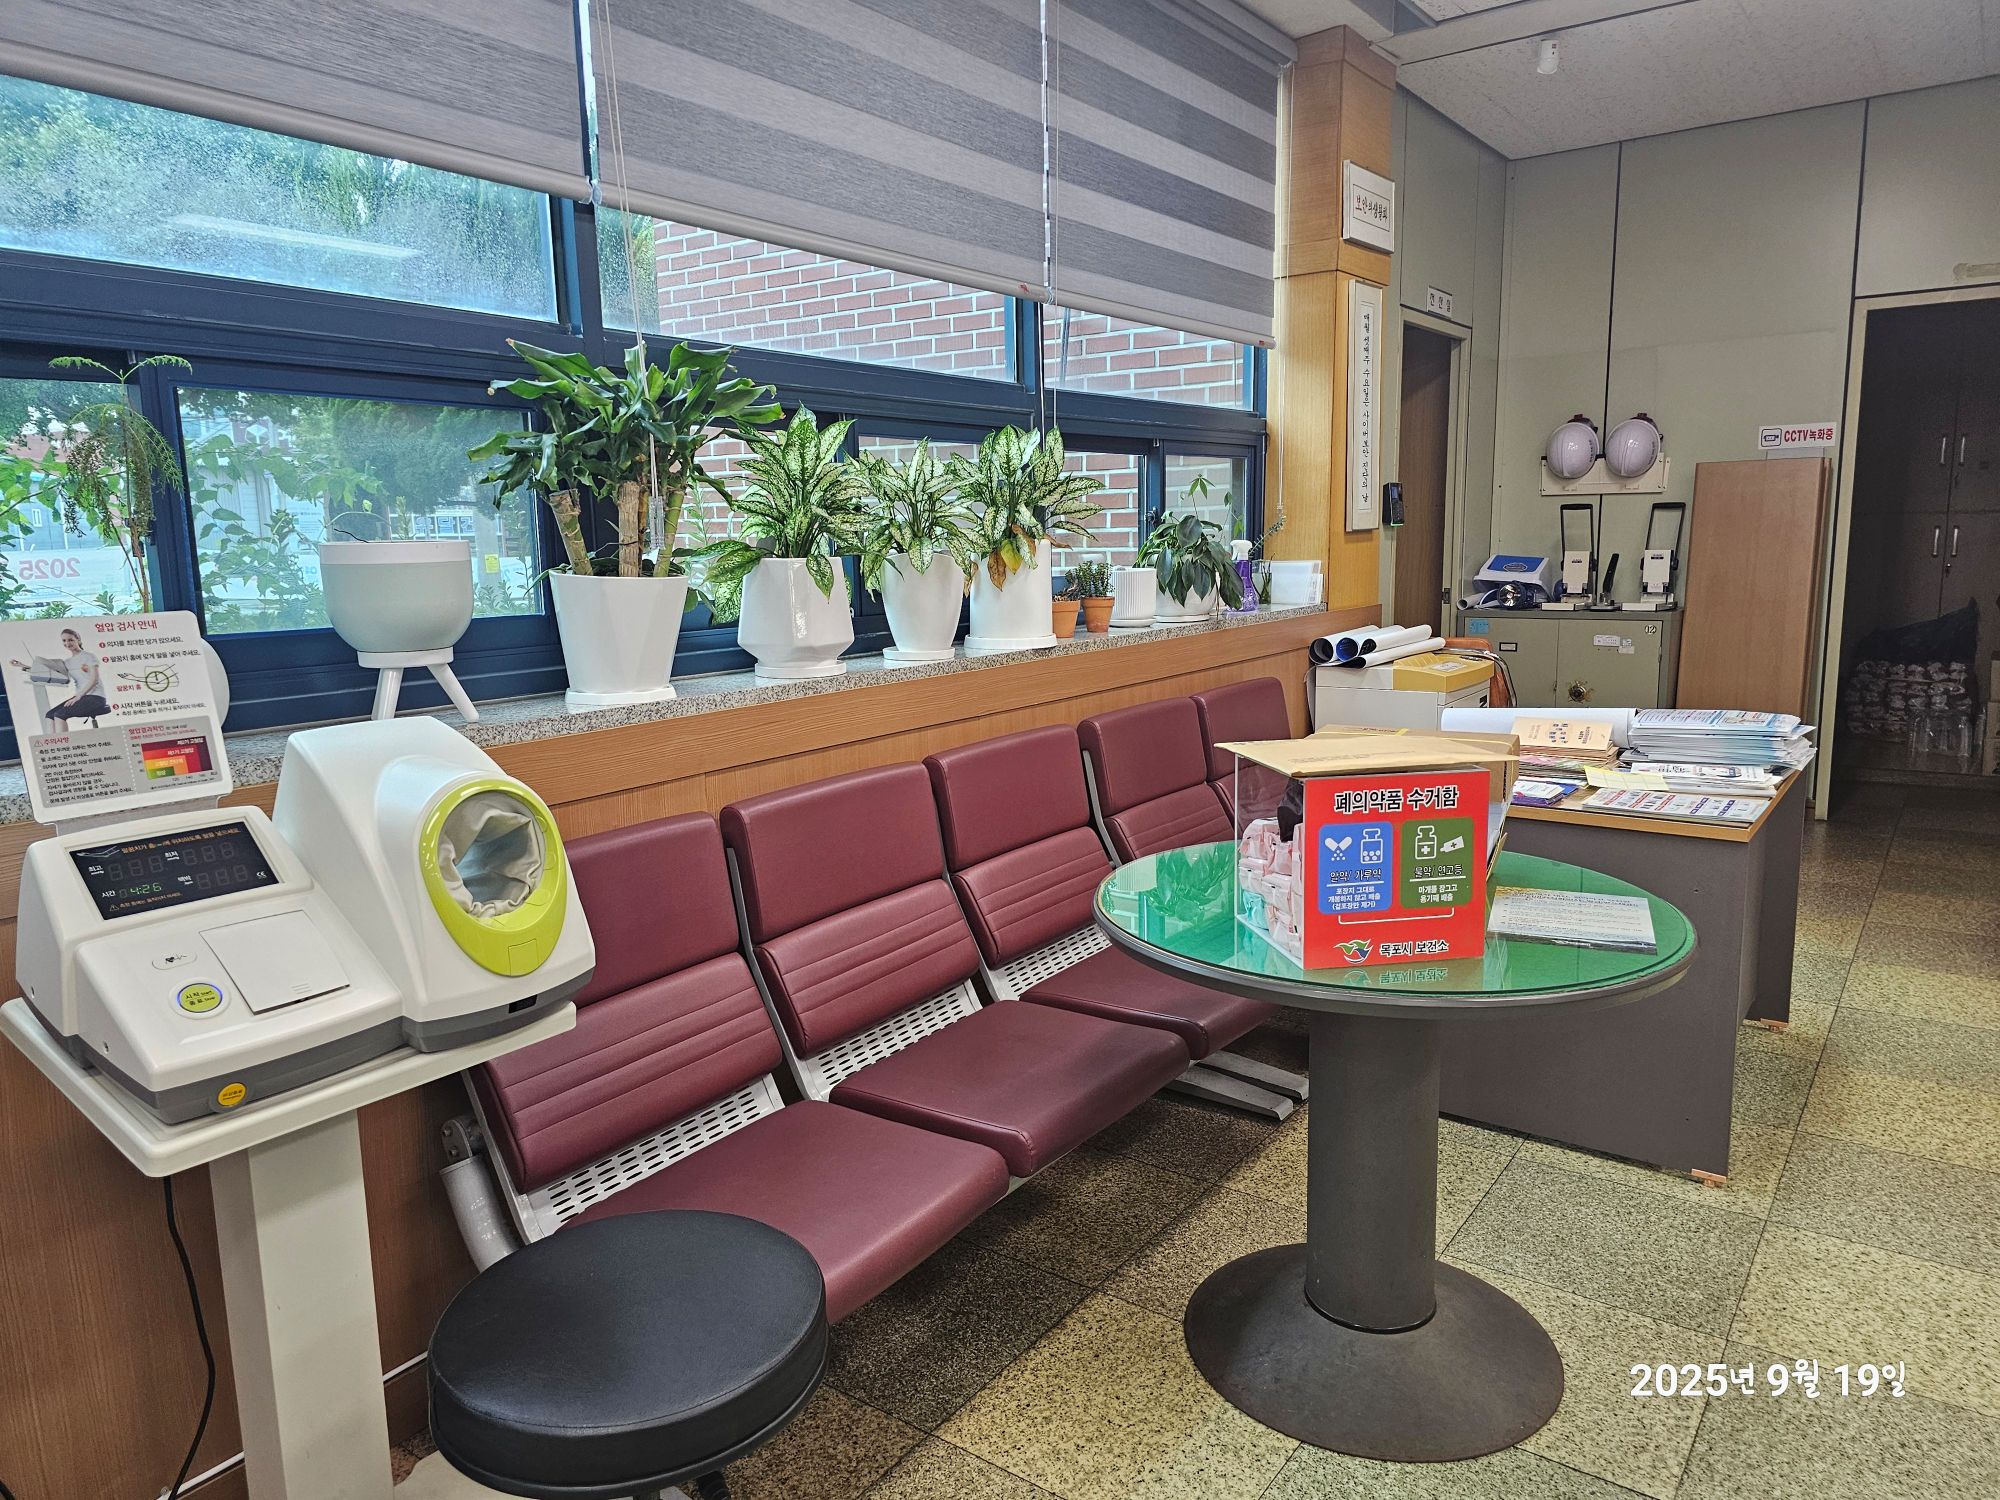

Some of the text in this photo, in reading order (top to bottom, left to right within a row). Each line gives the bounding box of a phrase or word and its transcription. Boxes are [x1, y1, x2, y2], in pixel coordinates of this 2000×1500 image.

[1784, 427, 1834, 442] CCTV녹화중
[94, 619, 157, 632] 혈압 검사 안내
[109, 655, 128, 663] 팔꿈치
[134, 700, 152, 708] 버튼을
[43, 736, 70, 745] 주의사항
[1334, 785, 1459, 814] 폐의약품 수거함
[1356, 869, 1381, 880] 가루약
[1438, 865, 1462, 875] 연고등
[1439, 884, 1457, 892] 잠그고
[1328, 894, 1352, 902] 개봉하지
[1441, 894, 1453, 902] 배출
[1380, 939, 1448, 956] 목포시 보건소
